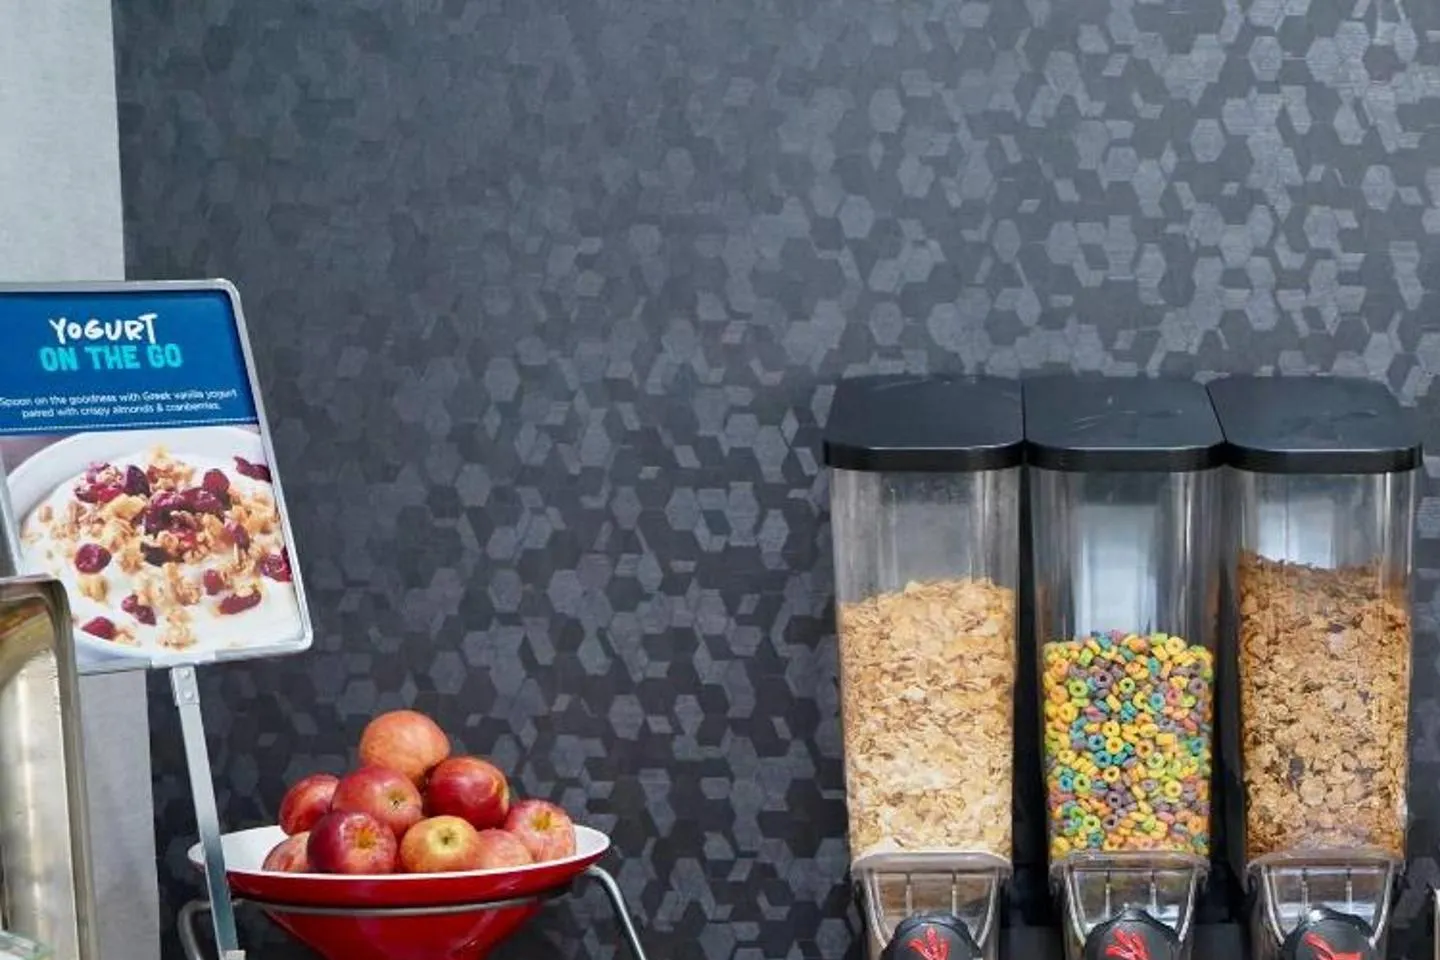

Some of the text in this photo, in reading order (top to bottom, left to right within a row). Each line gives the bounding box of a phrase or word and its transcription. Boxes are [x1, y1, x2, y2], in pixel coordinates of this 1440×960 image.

[49, 313, 158, 344] YOGURT
[40, 342, 183, 371] ON THE GO
[34, 395, 49, 405] on
[49, 394, 67, 405] the
[68, 392, 117, 406] goodness
[119, 391, 140, 401] with
[22, 408, 54, 419] paired
[56, 406, 80, 417] with
[112, 403, 154, 415] almonds
